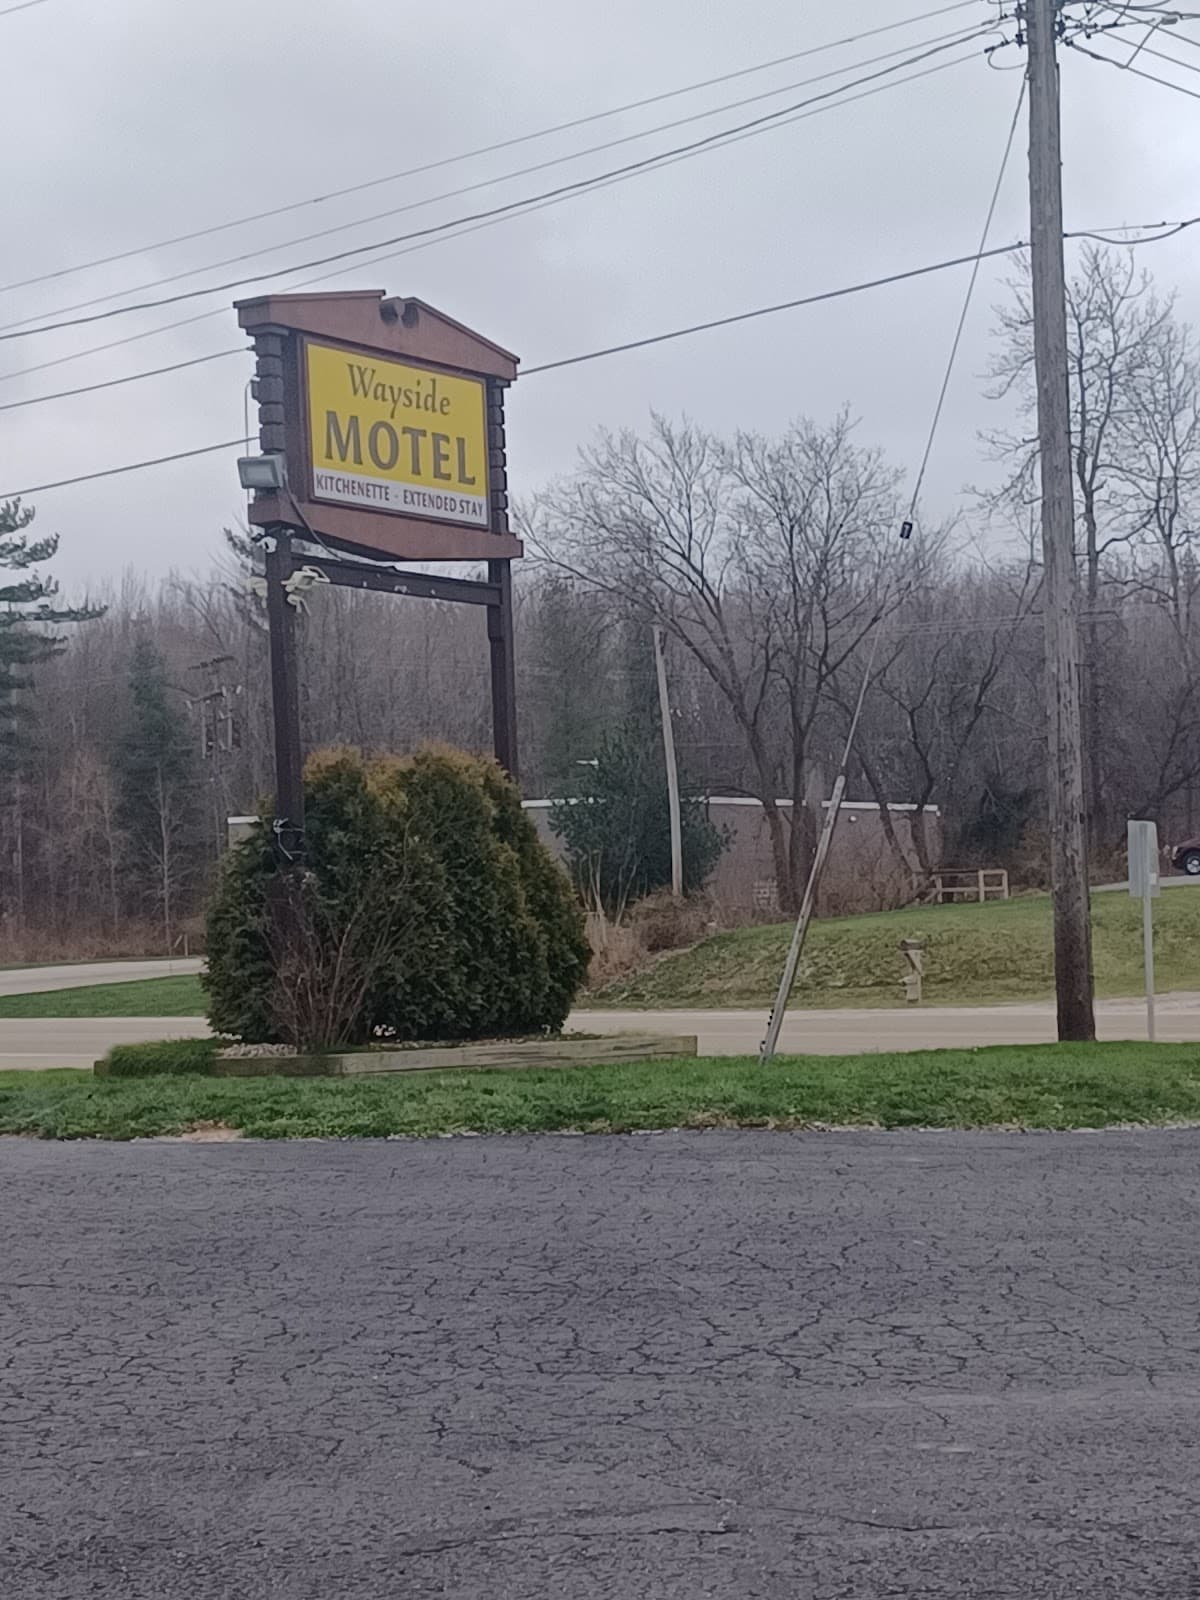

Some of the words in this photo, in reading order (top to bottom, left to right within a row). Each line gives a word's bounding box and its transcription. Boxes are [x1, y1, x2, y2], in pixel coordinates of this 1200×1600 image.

[347, 363, 450, 419] Wayside
[325, 410, 476, 486] MOTEL
[316, 474, 390, 501] KITCHENETTE
[403, 489, 457, 513] EXTENDED
[459, 500, 483, 517] STAY
